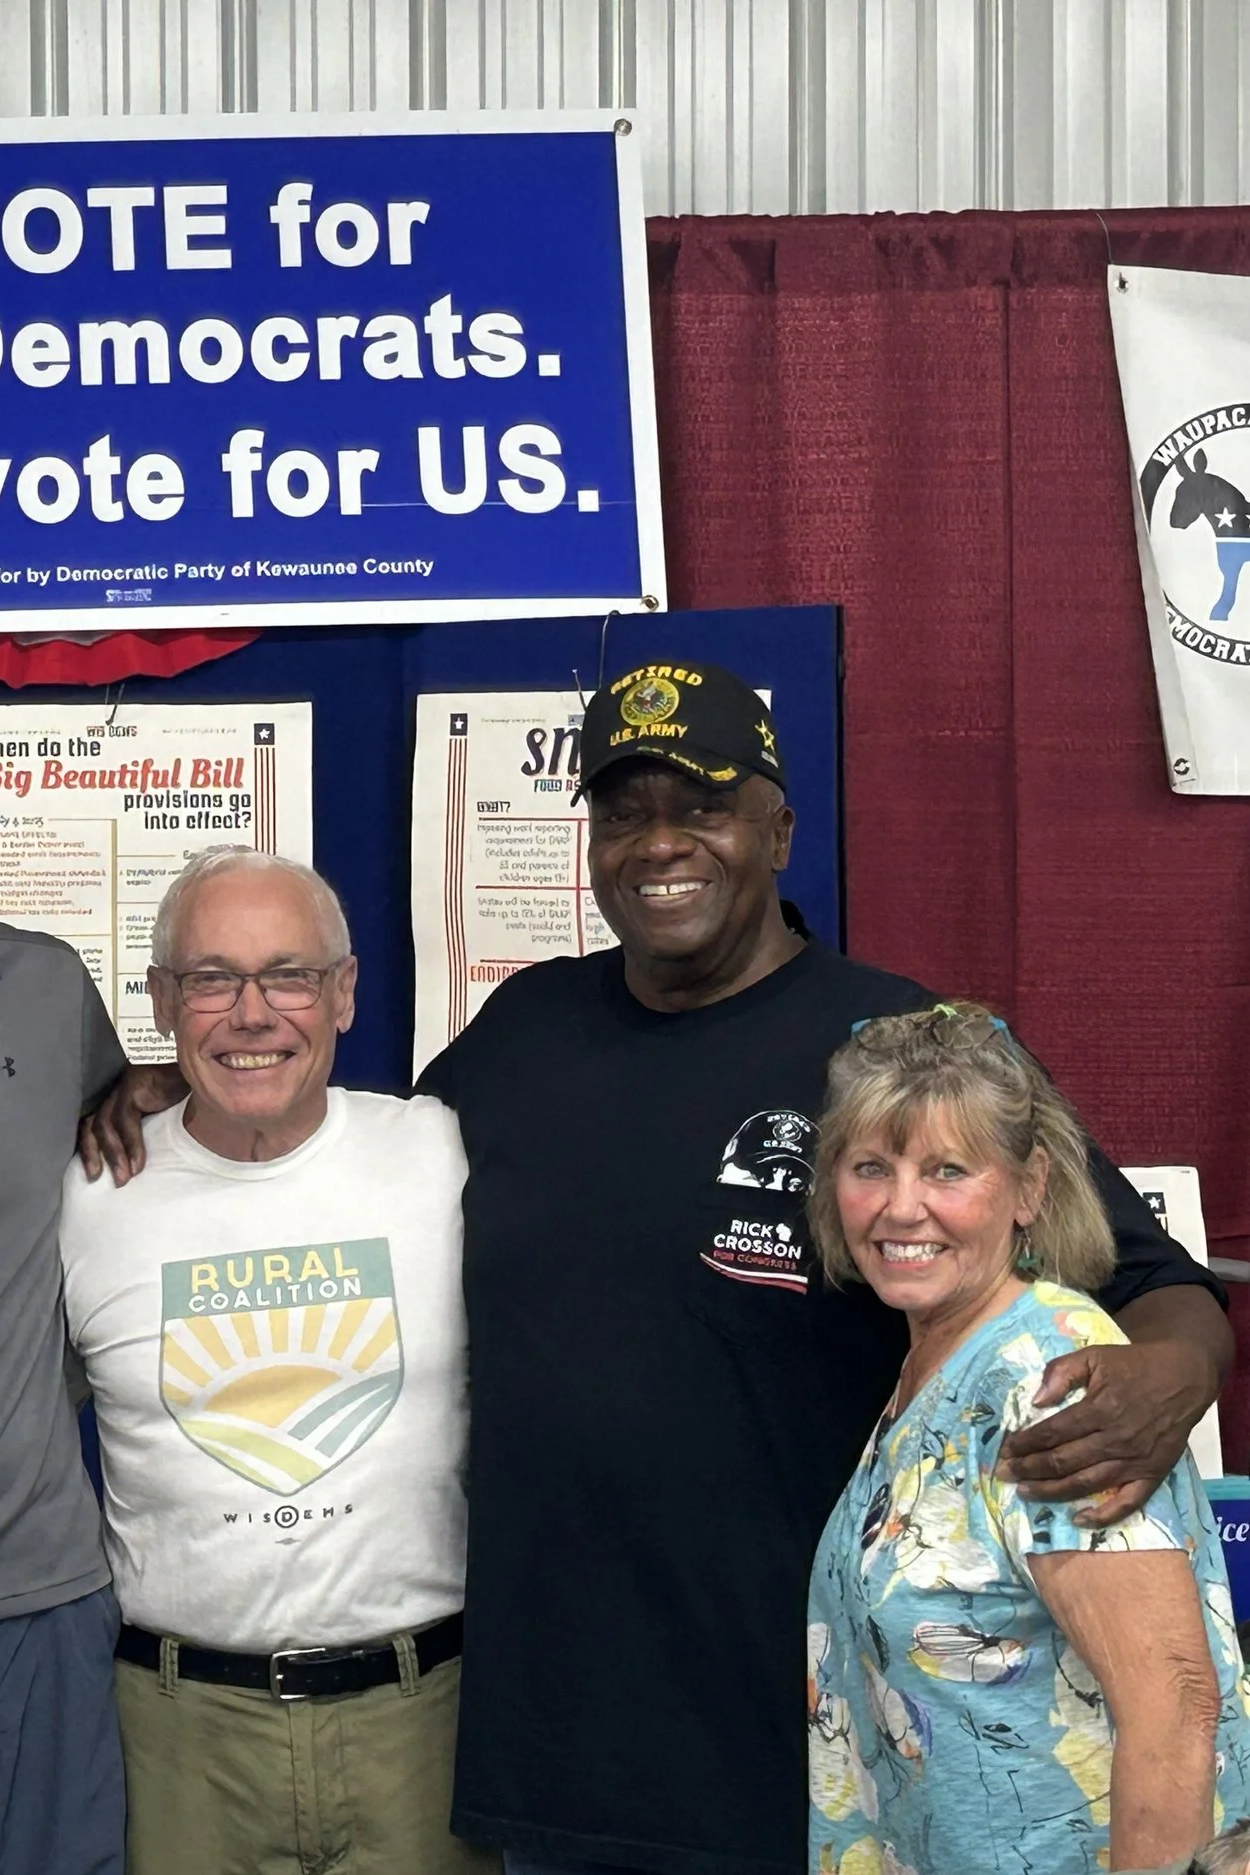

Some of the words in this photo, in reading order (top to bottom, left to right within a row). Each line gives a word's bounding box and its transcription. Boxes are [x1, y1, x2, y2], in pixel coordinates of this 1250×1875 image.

[269, 181, 432, 268] for
[1152, 406, 1250, 467] WAUPAC
[221, 427, 390, 518] for
[417, 422, 600, 515] US.
[26, 566, 51, 587] by
[56, 562, 169, 582] Democratic
[174, 562, 226, 581] Party
[231, 560, 251, 578] of
[256, 559, 358, 577] Kewaunee
[363, 557, 434, 577] County
[1166, 606, 1250, 663] MOCRA
[610, 665, 703, 695] RETIRED
[637, 723, 689, 739] ARMY
[37, 737, 62, 757] do
[68, 736, 101, 757] the
[41, 758, 181, 793] Beautiful
[190, 757, 244, 789] Bill
[124, 790, 223, 812] provisions
[229, 794, 251, 812] go
[144, 811, 180, 830] into
[186, 811, 251, 830] effect?
[730, 1219, 774, 1239] RICK
[713, 1233, 803, 1260] CROSSON
[191, 1246, 359, 1294] RURAL
[188, 1277, 362, 1314] COALITION
